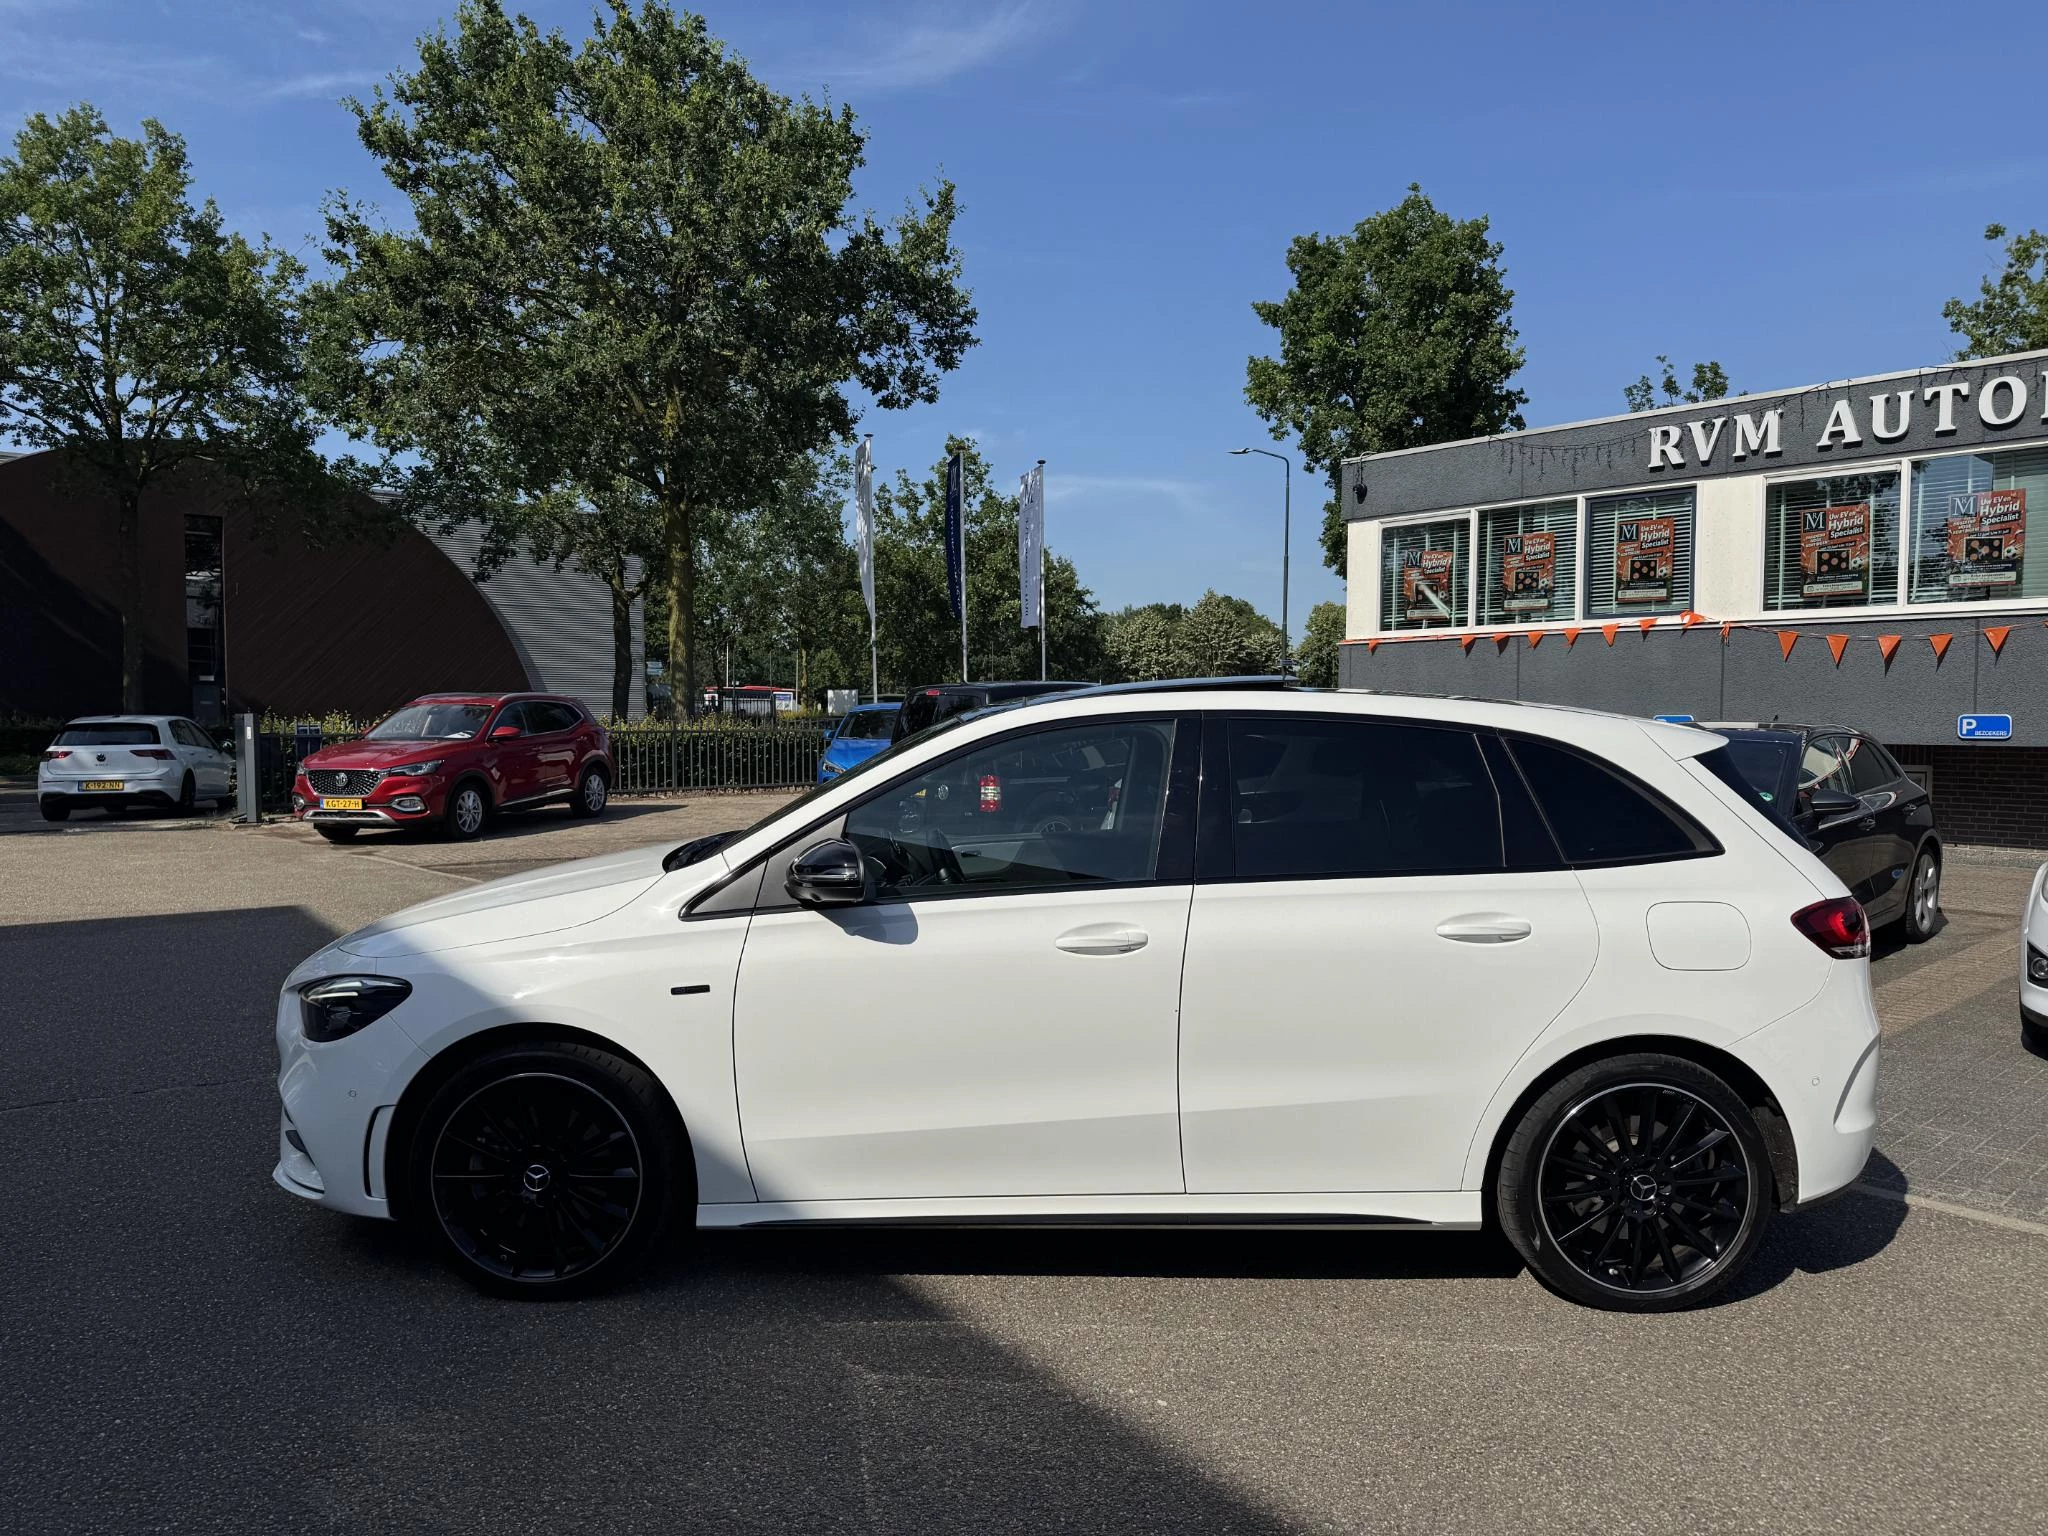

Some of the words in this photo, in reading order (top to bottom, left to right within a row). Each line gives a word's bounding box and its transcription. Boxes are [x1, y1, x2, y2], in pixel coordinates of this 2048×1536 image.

[1648, 408, 1784, 468] RVM
[1816, 371, 2048, 447] AUTO
[1993, 495, 2004, 503] EV
[1980, 501, 2020, 517] Hybrid
[1828, 515, 1864, 531] Hybrid
[1981, 513, 2019, 525] Specialist
[1640, 529, 1670, 542] Hybrid
[1830, 526, 1863, 539] Specialist
[1524, 542, 1551, 554] Hybrid
[1642, 539, 1669, 549] Specialist
[1422, 559, 1448, 569] Hybrid
[1961, 718, 1977, 735] P
[326, 800, 360, 808] KGT-27-H
